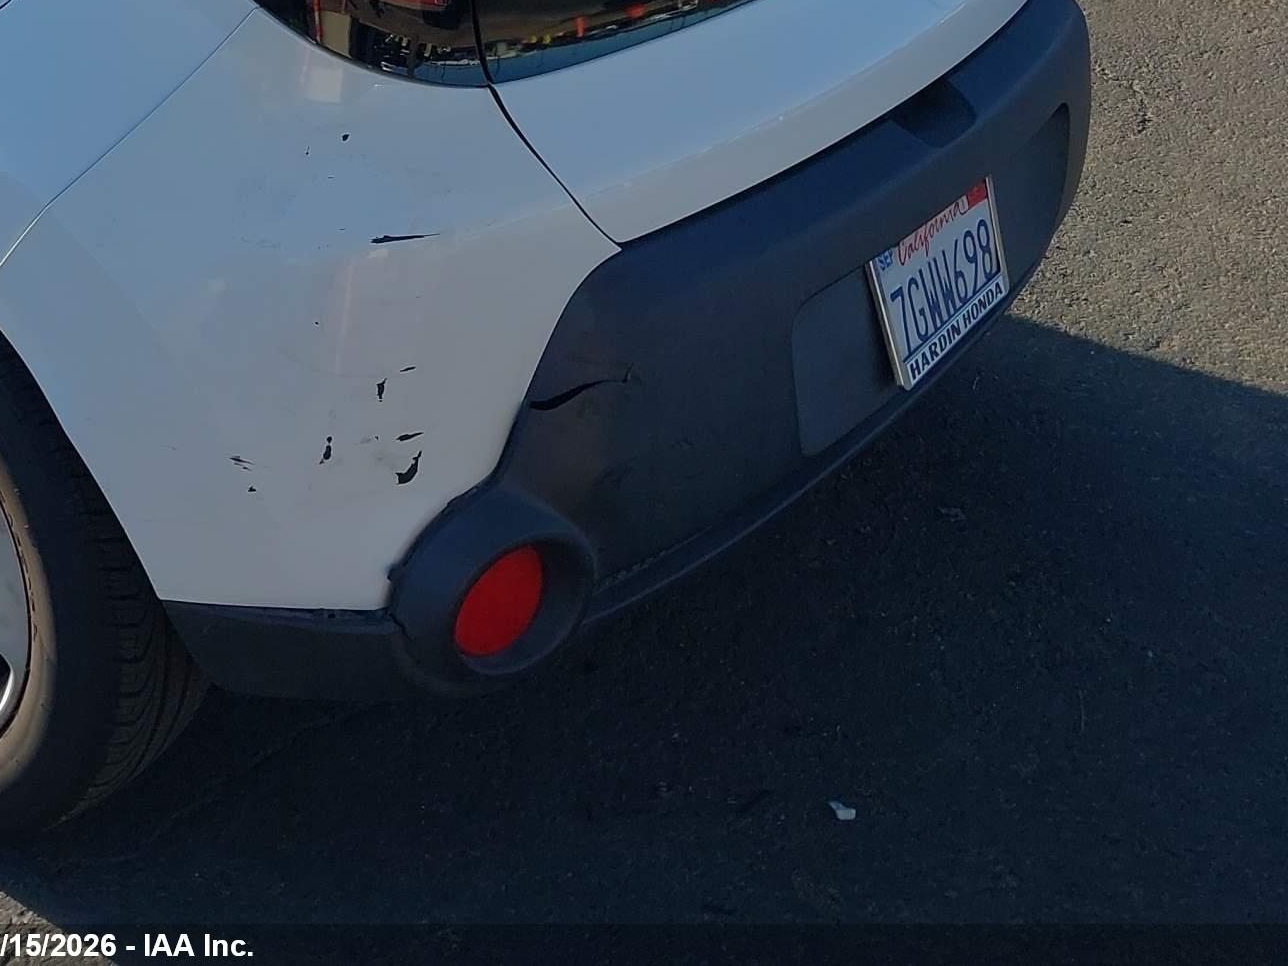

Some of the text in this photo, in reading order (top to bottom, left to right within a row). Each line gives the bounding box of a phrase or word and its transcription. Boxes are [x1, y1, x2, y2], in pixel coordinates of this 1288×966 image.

[890, 218, 994, 355] 7GWW698
[910, 282, 1003, 379] HARDIN HONDA
